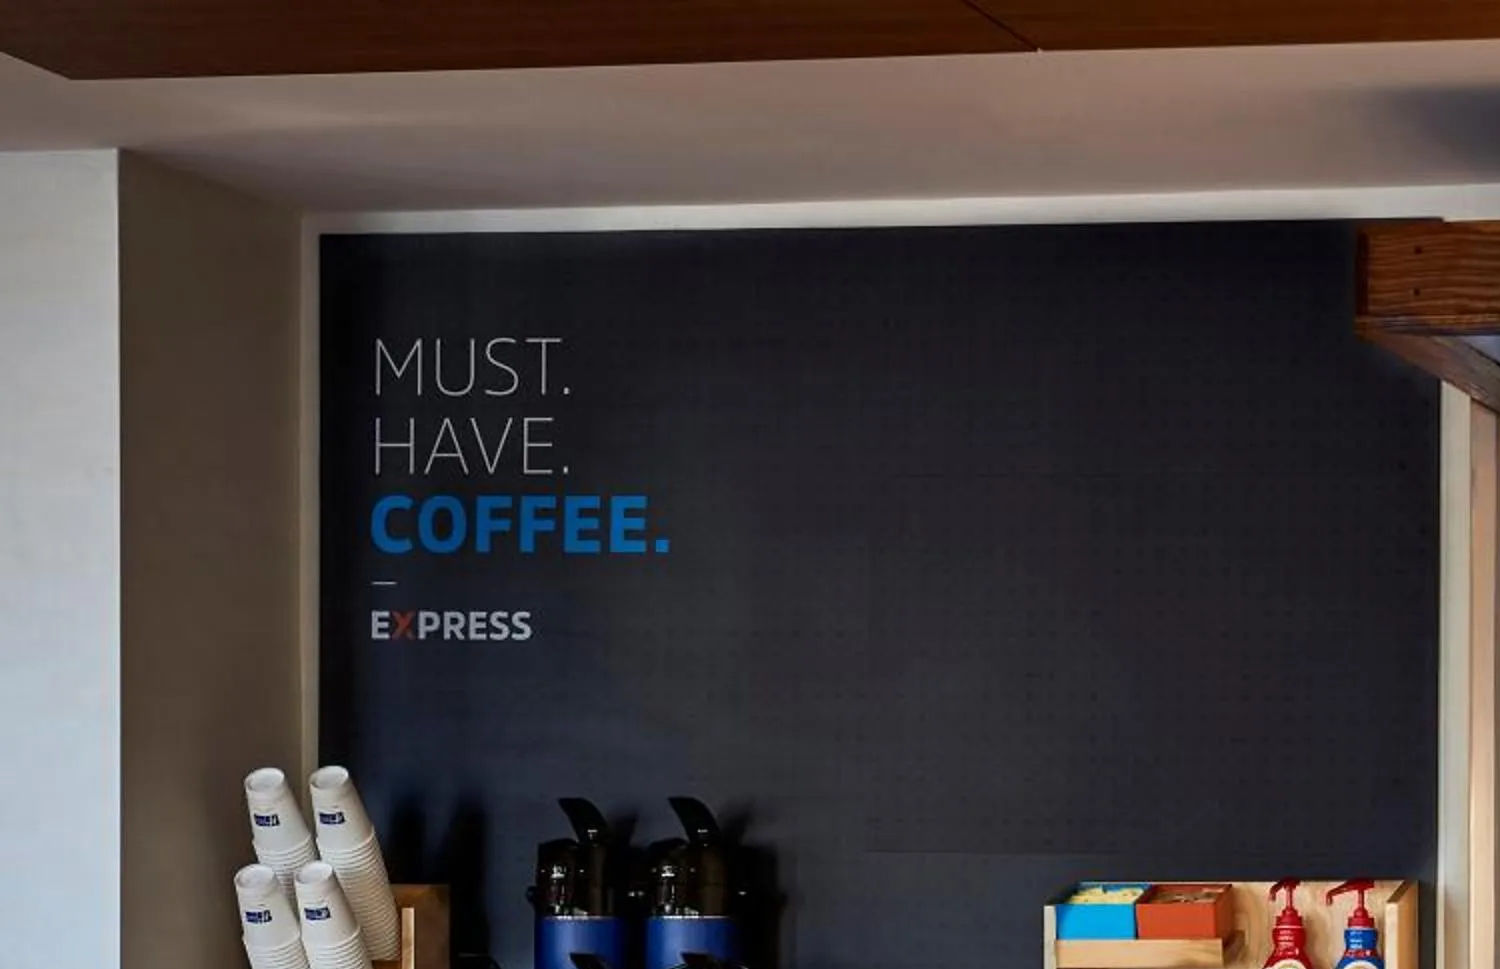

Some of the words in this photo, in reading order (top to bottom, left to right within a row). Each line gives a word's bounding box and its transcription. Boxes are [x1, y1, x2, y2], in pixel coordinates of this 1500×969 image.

[375, 338, 571, 397] MUST.
[375, 417, 569, 475] HAVE.
[370, 494, 671, 554] COFFEE.
[371, 611, 533, 641] EXPRESS
